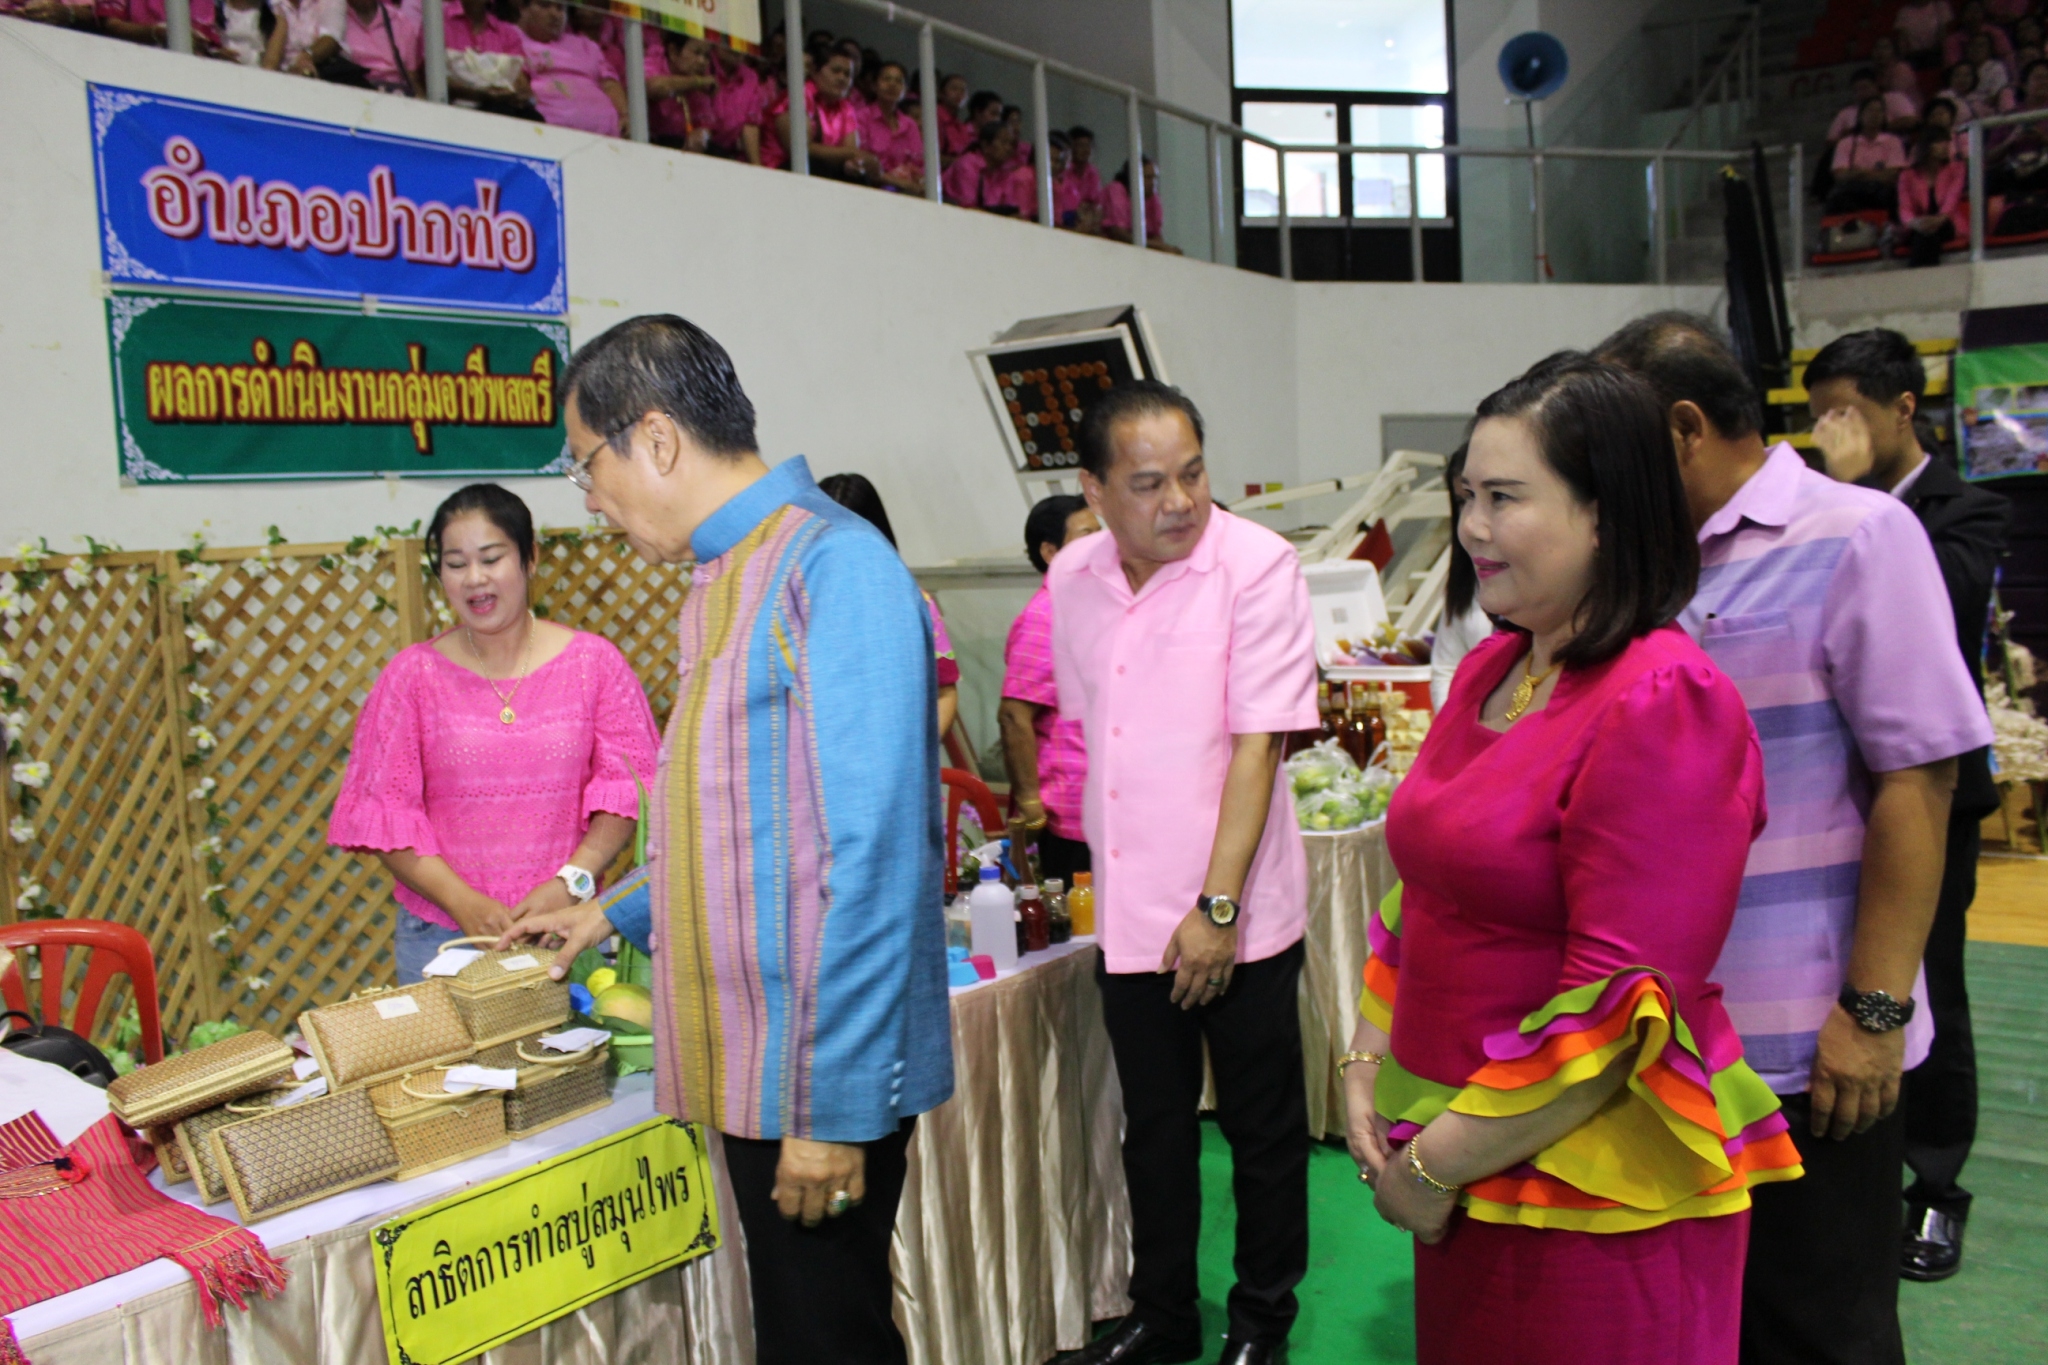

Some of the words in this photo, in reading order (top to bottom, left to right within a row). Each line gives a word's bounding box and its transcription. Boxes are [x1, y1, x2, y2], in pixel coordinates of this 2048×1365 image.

[141, 136, 535, 272] อำเภอปากท่อ
[146, 338, 556, 454] ผลการดำเนินงานกลุ่มอาชีพสตรี
[405, 1156, 690, 1319] สาธิตการทำสบู่สมุนไพร
